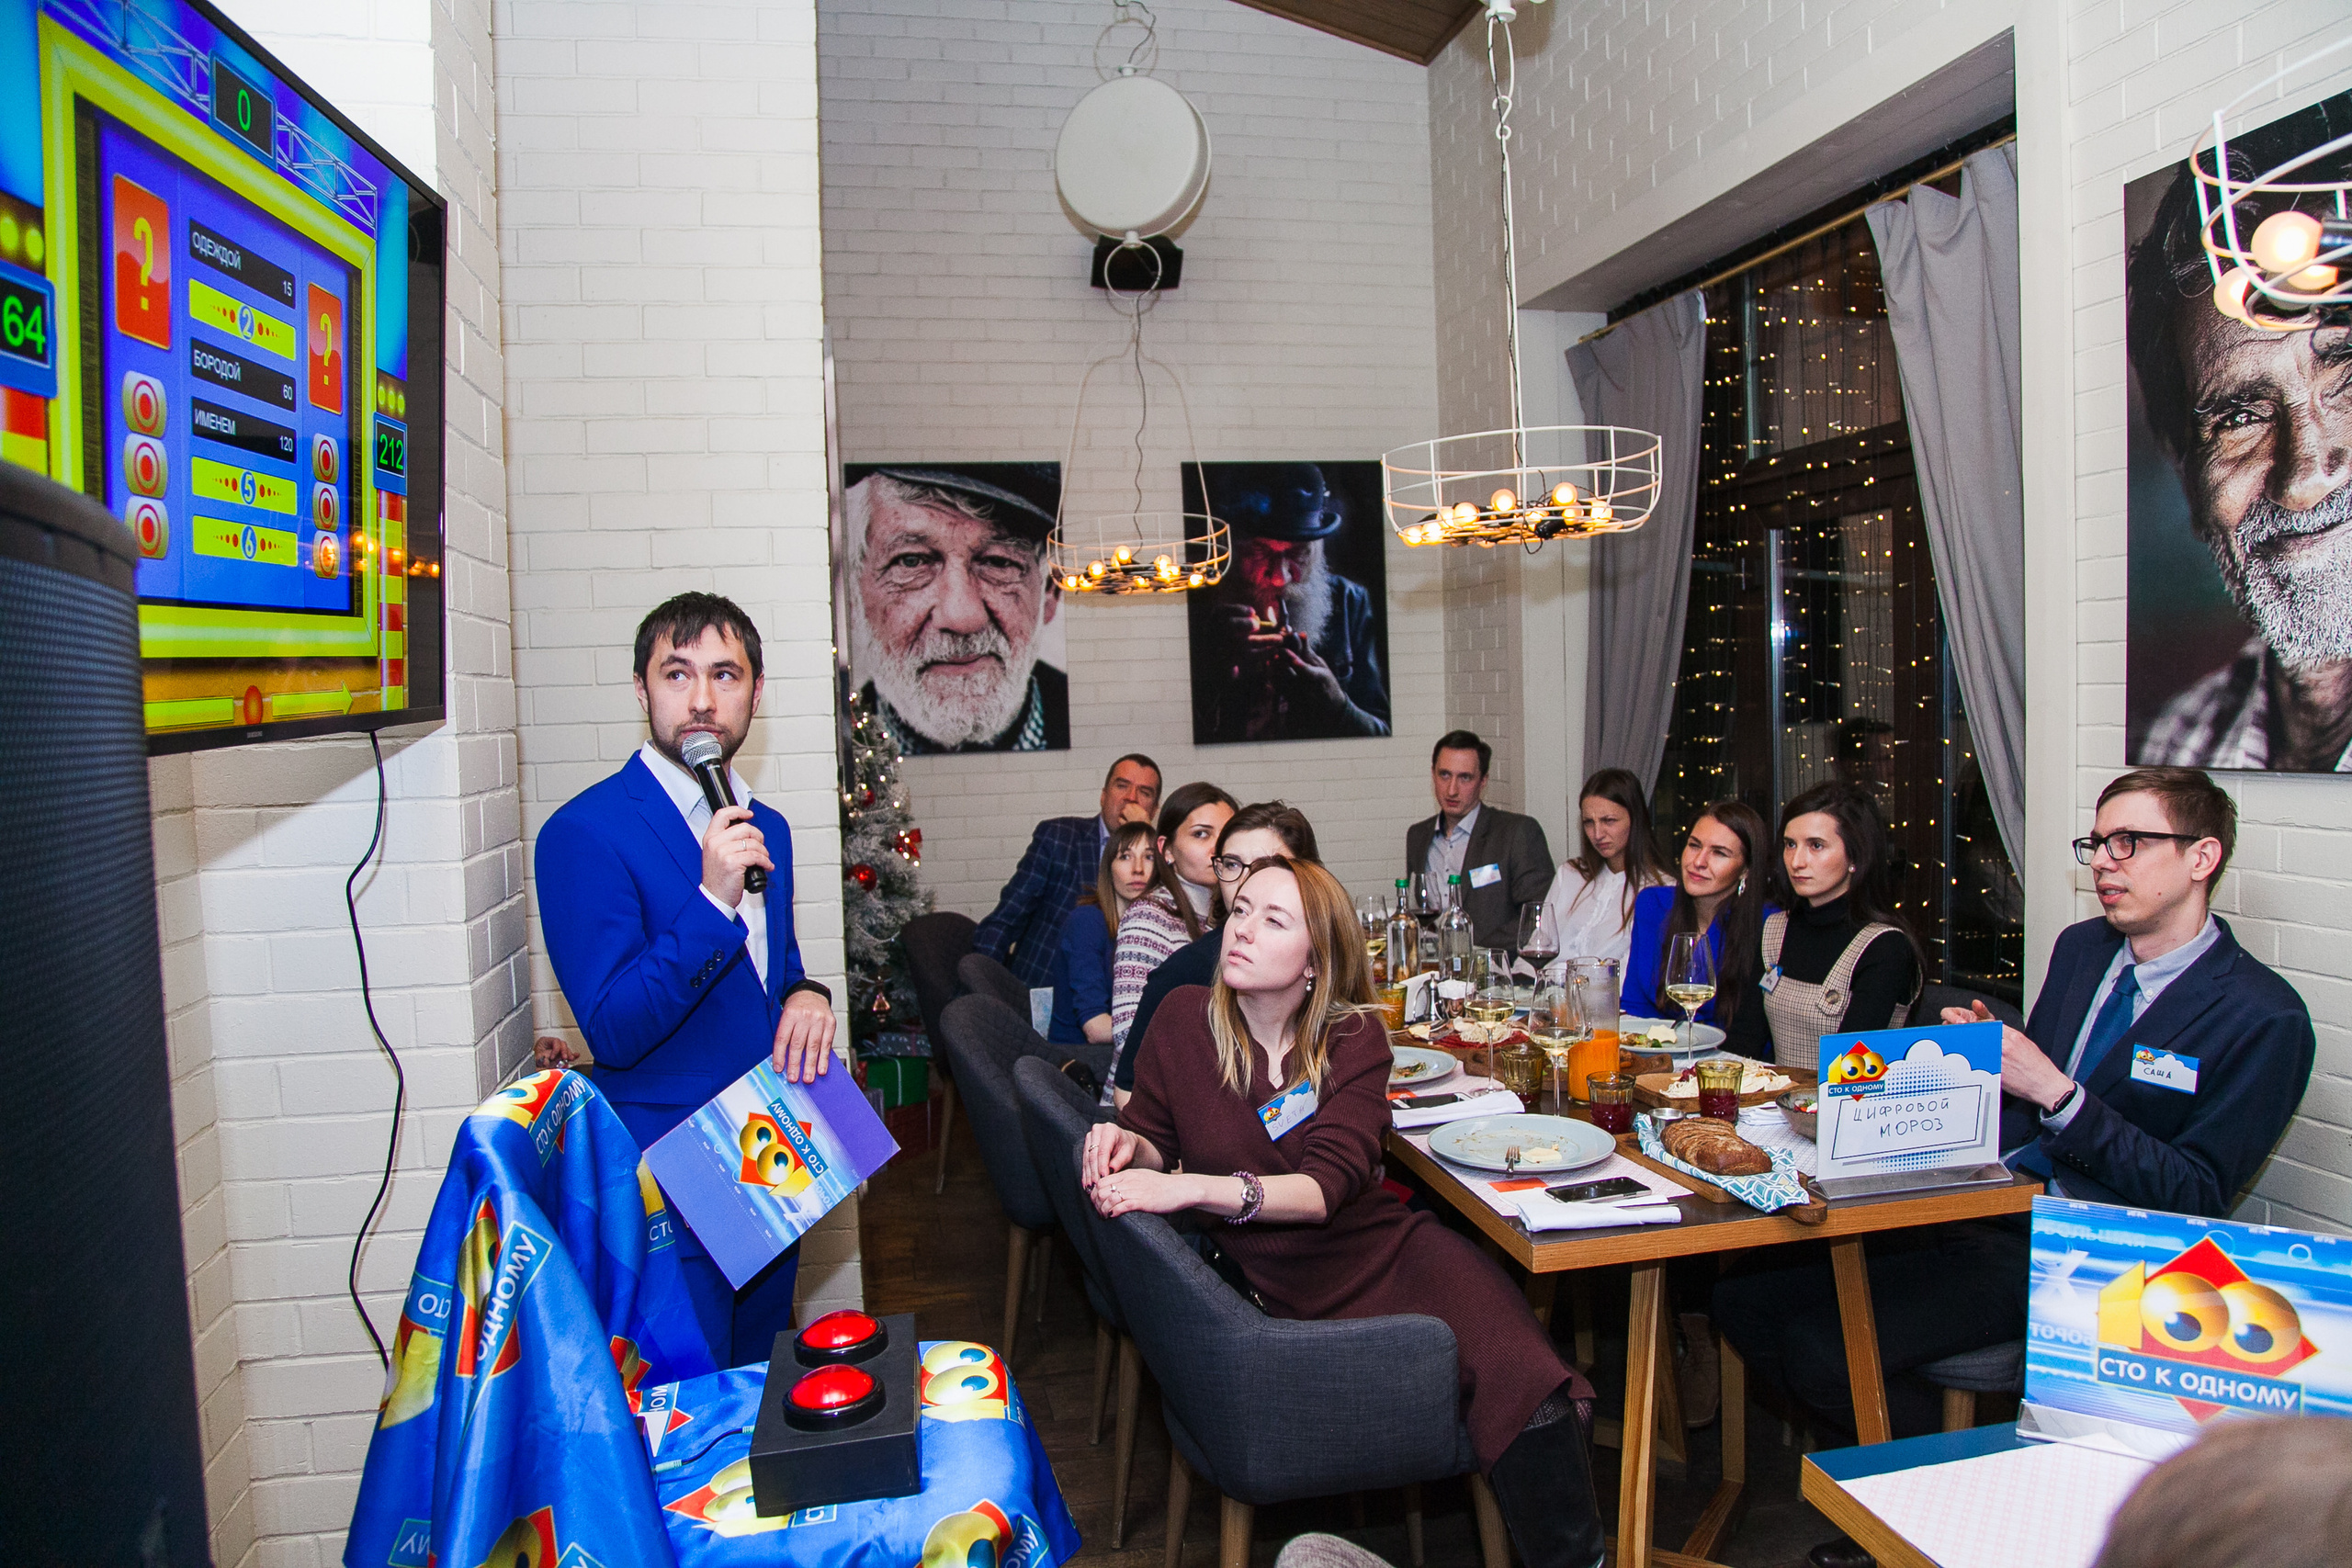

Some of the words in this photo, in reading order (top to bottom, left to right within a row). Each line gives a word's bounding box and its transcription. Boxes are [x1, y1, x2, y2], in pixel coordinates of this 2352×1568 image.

[237, 89, 251, 131] 0
[192, 231, 242, 271] ОДЕЖДОЙ
[283, 280, 293, 297] 15
[2, 295, 46, 355] 64
[242, 307, 253, 337] 2
[193, 349, 242, 382] БОРОДОЙ
[282, 384, 293, 400] 60
[194, 408, 236, 435] ИМЕНЕМ
[279, 435, 294, 452] 120
[379, 434, 404, 469] 212
[243, 473, 254, 503] 5
[244, 528, 254, 557] 6
[1828, 1086, 1843, 1095] СТО
[1851, 1083, 1884, 1093] ОДНОМУ
[2143, 1067, 2172, 1079] САША
[536, 1128, 548, 1155] СТО
[546, 1118, 553, 1133] К
[551, 1077, 586, 1126] ОДНОМУ
[771, 1102, 804, 1145] ОДНОМУ
[1853, 1098, 1950, 1122] ЦИФРОВОЙ
[1880, 1118, 1944, 1138] МОРОЗ
[801, 1145, 810, 1155] К
[808, 1154, 824, 1174] СТО
[2099, 1357, 2146, 1382] СТО
[2154, 1366, 2172, 1387] К
[2179, 1371, 2299, 1409] ОДНОМУ
